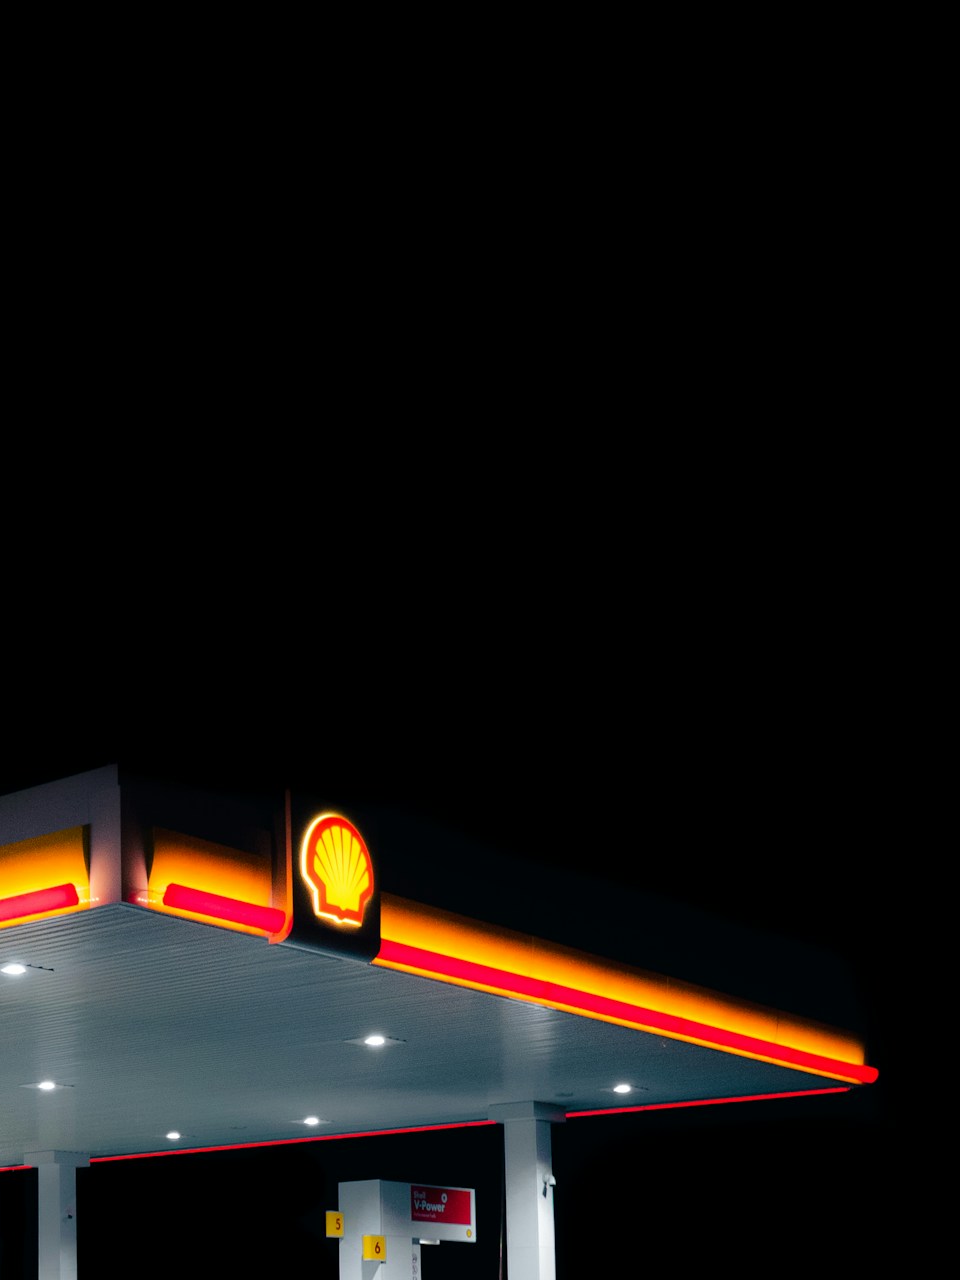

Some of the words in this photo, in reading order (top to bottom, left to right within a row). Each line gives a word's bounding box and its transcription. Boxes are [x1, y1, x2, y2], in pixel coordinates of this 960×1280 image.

[413, 1200, 446, 1213] V-Power
[335, 1218, 341, 1230] 5
[374, 1241, 381, 1254] 6
